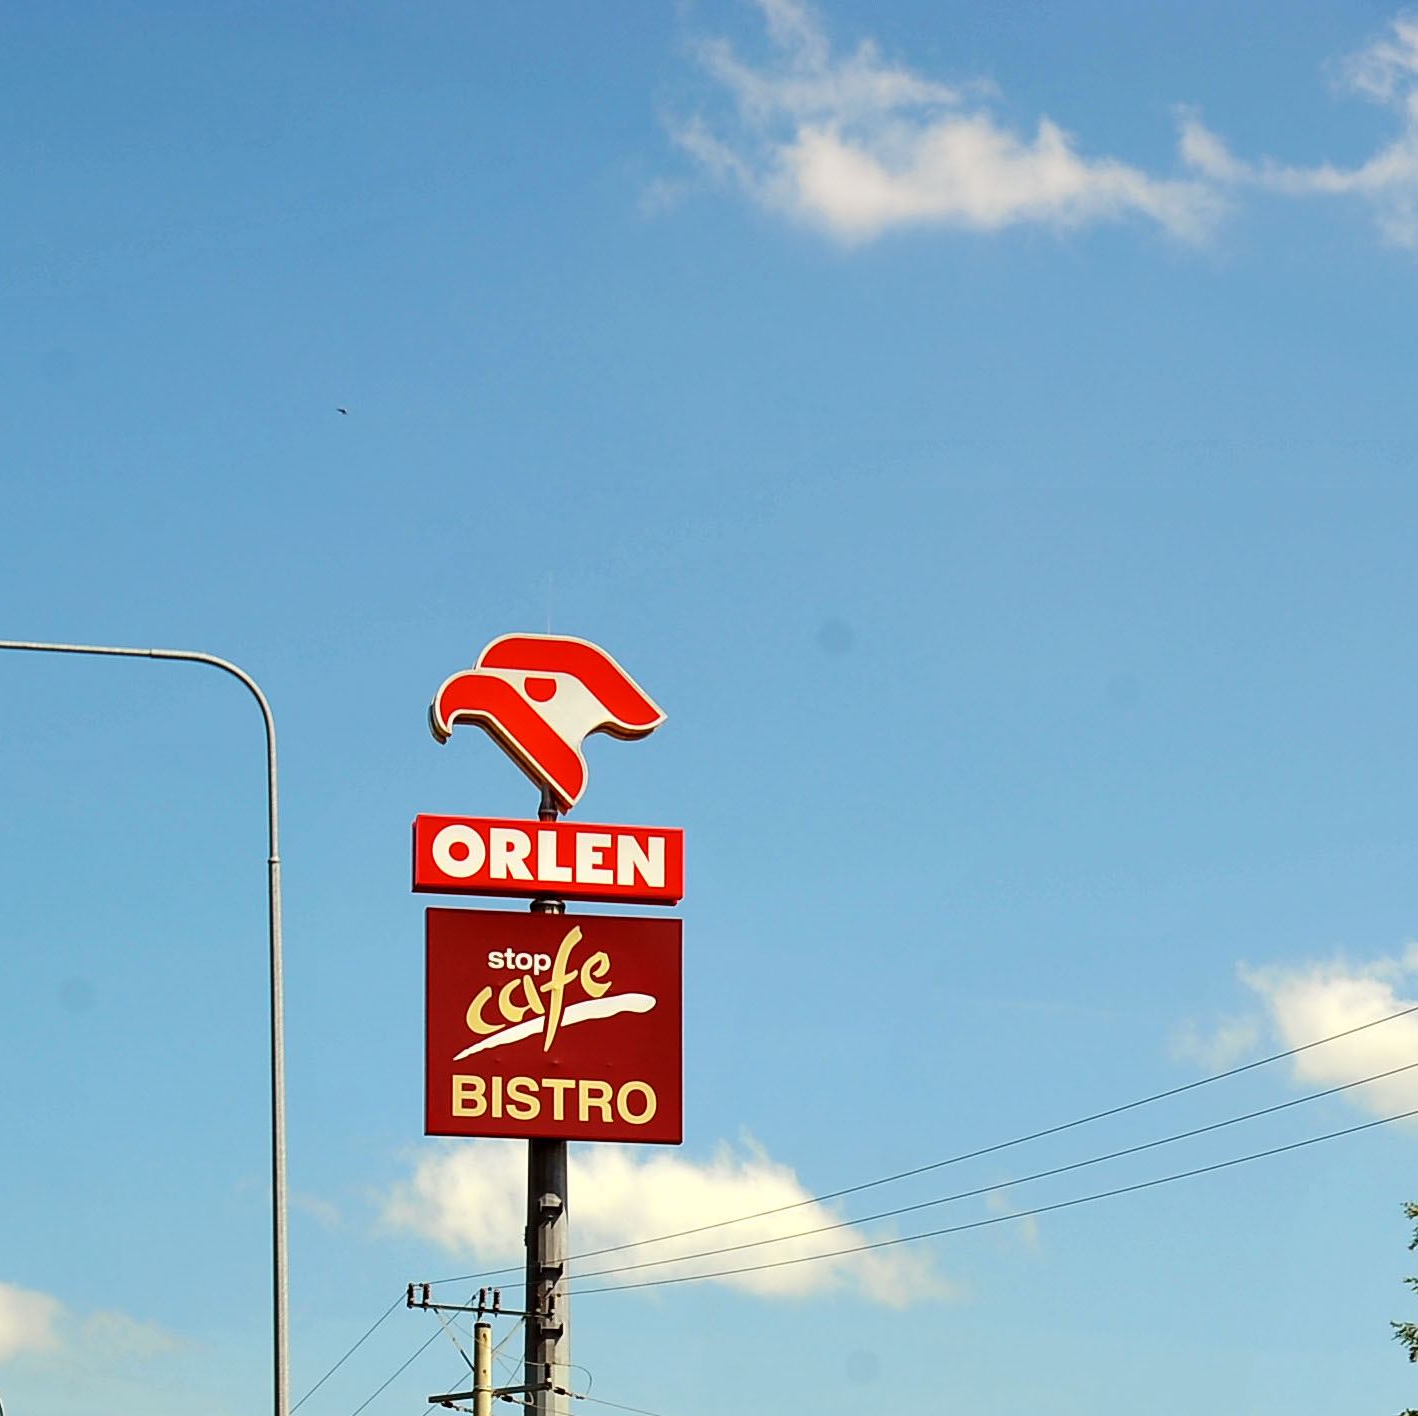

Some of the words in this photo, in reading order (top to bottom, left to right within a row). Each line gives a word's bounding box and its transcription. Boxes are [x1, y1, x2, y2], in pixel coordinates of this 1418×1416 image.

[432, 825, 665, 887] ORLEN
[488, 948, 551, 973] stop
[466, 925, 612, 1052] cafe
[452, 1075, 657, 1124] BISTRO
